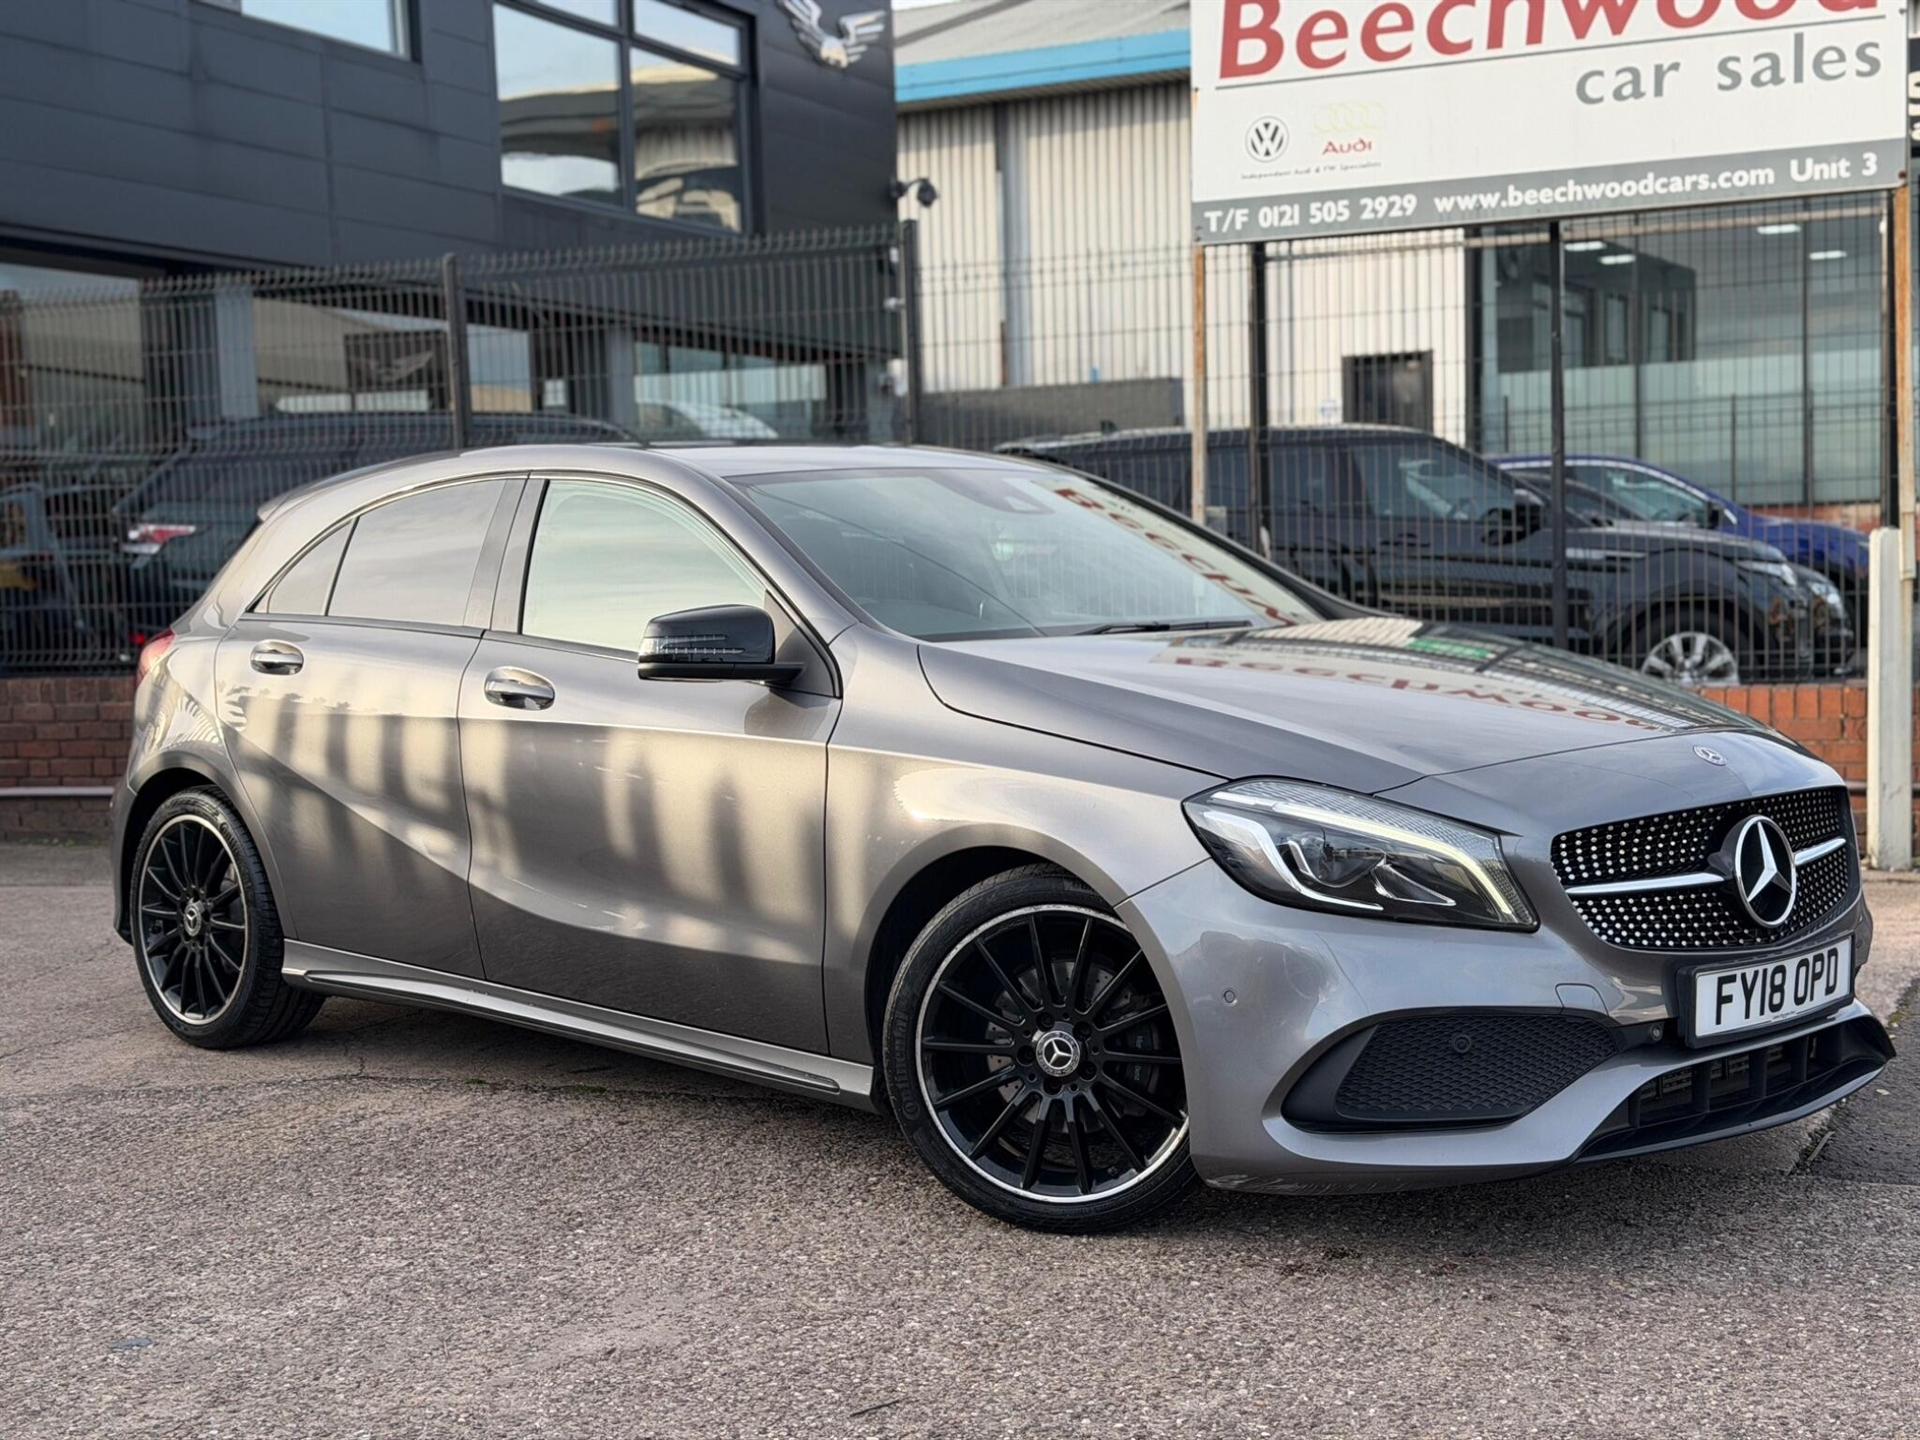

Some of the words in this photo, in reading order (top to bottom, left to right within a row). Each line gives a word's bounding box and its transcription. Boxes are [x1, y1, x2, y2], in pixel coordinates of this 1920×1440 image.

[1575, 61, 1681, 105] car
[1716, 32, 1882, 92] sales
[1322, 137, 1373, 156] Audi
[1203, 208, 1250, 233] T/F
[1258, 206, 1300, 229] 0121
[1309, 199, 1351, 225] 505
[1359, 194, 1418, 220] 2929
[1433, 167, 1775, 213] www.beechwoodcars.com
[1790, 156, 1851, 183] Unit
[1861, 152, 1878, 177] 3
[1715, 964, 1787, 1026] FY18
[1793, 947, 1839, 1007] OPD
